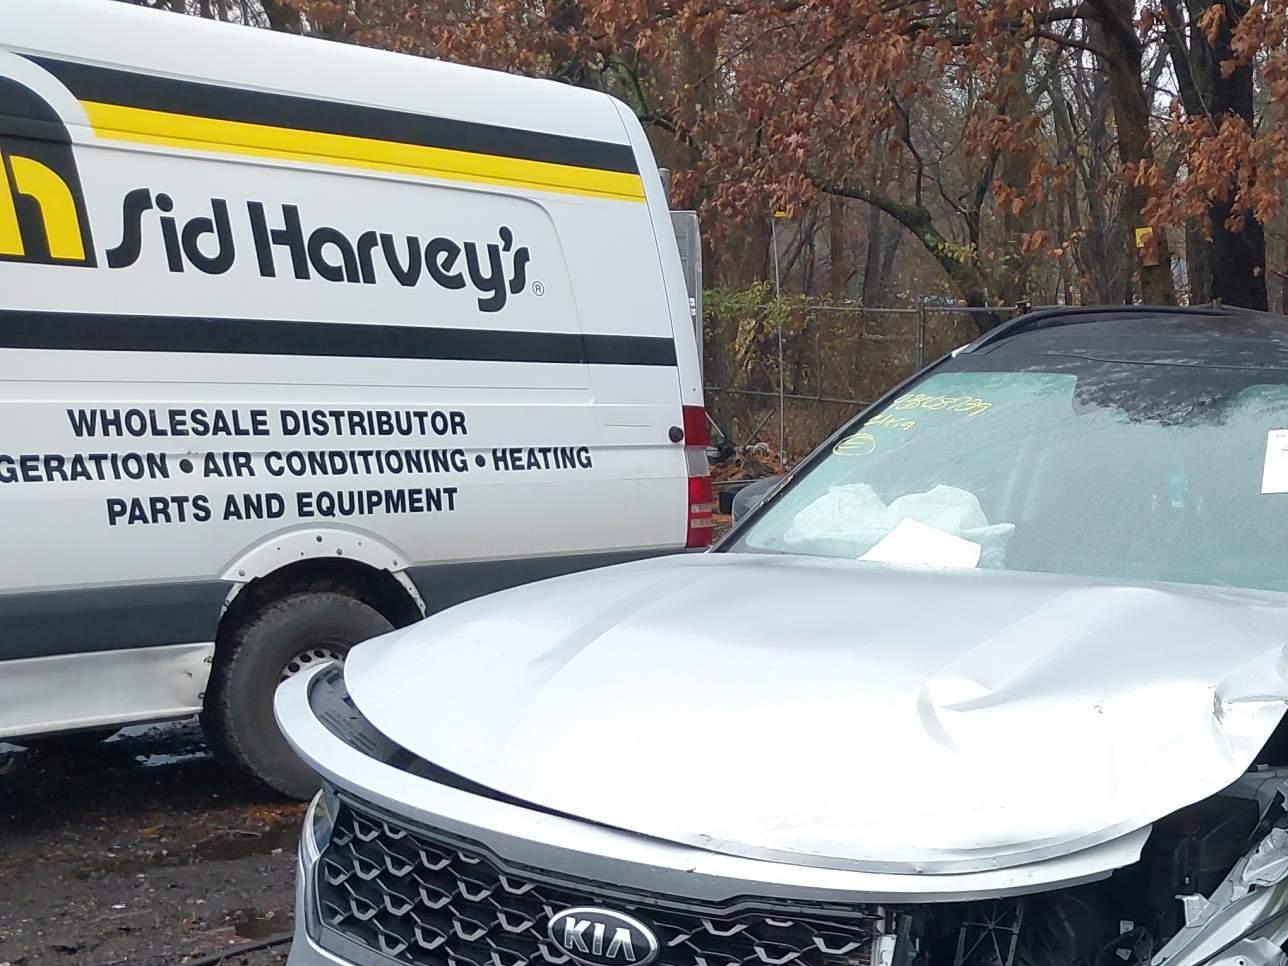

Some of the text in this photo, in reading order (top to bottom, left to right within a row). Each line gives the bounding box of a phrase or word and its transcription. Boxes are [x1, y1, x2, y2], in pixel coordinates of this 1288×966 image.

[105, 187, 531, 313] Sid Harvey's
[67, 408, 468, 438] WHOLESALE DISTRIBUTOR
[0, 446, 593, 483] GERATION AIR CONDITIONING HEATING
[106, 487, 458, 526] PARTS AND EQUIPMENT
[564, 916, 637, 962] KIA
